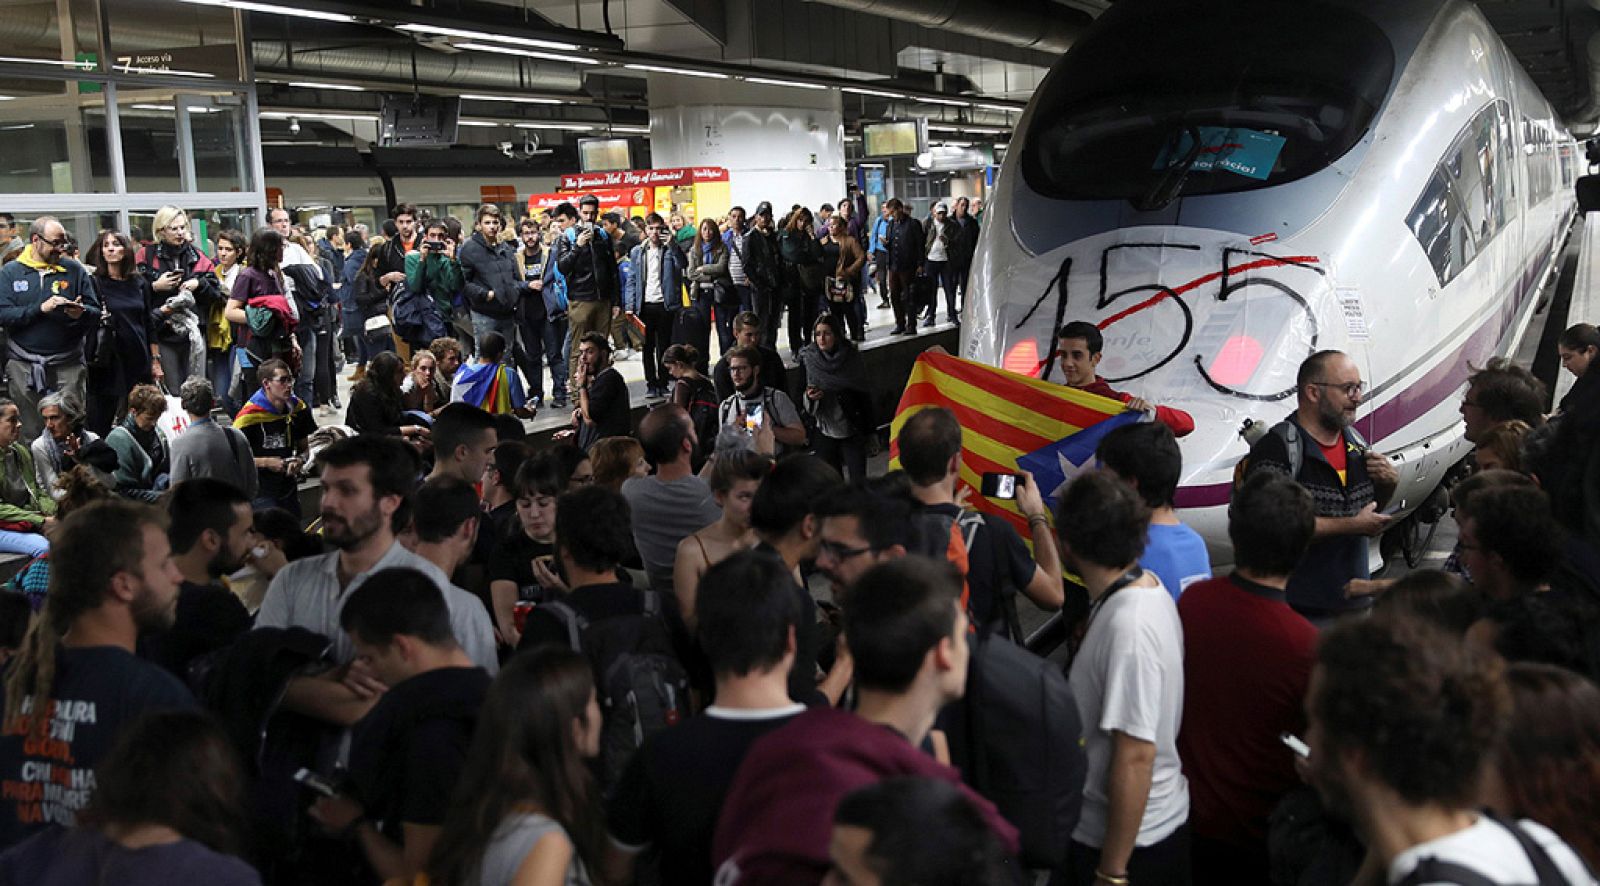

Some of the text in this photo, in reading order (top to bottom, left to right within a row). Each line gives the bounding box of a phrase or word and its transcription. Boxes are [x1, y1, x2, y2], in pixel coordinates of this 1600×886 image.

[117, 56, 132, 74] 7
[565, 177, 577, 188] The
[605, 172, 622, 185] Hot
[623, 171, 641, 185] Dog
[641, 172, 650, 184] of
[1014, 243, 1326, 401] 155
